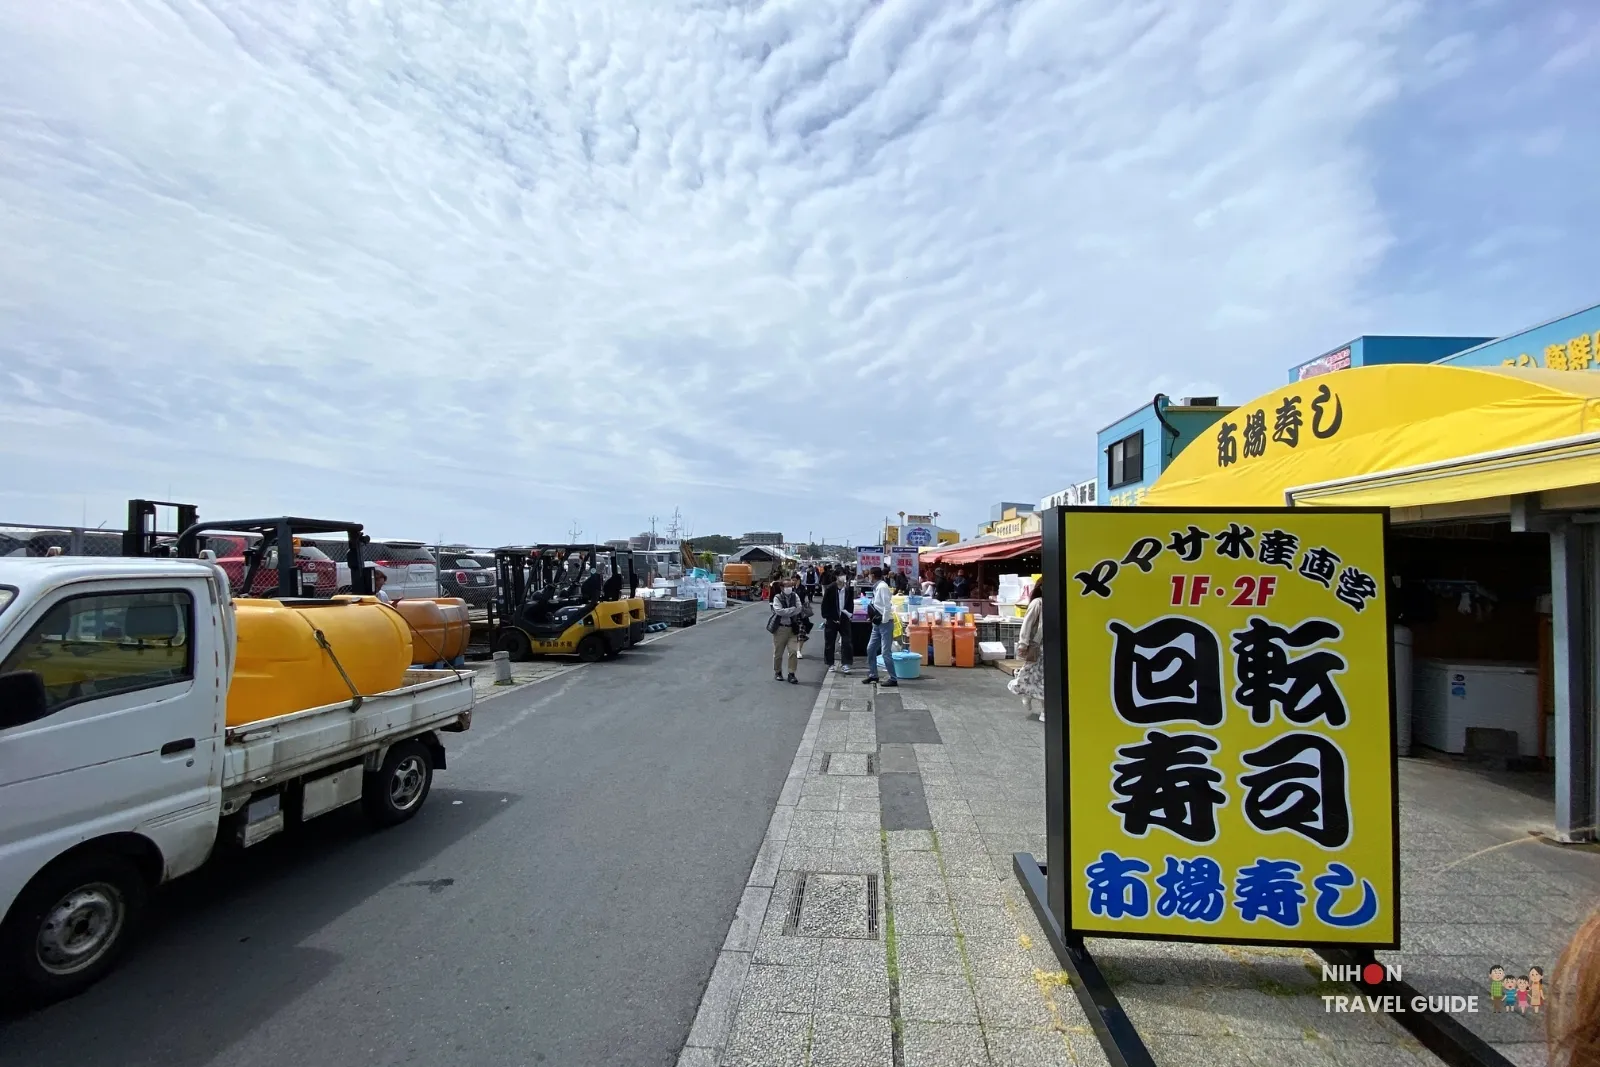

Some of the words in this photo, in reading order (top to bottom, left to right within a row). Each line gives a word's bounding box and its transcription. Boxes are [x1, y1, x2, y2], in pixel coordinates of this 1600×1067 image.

[1216, 383, 1344, 468] 市場寿し
[1108, 615, 1349, 728] 回転
[1109, 729, 1351, 849] 寿司
[1083, 851, 1379, 928] 市場寿し
